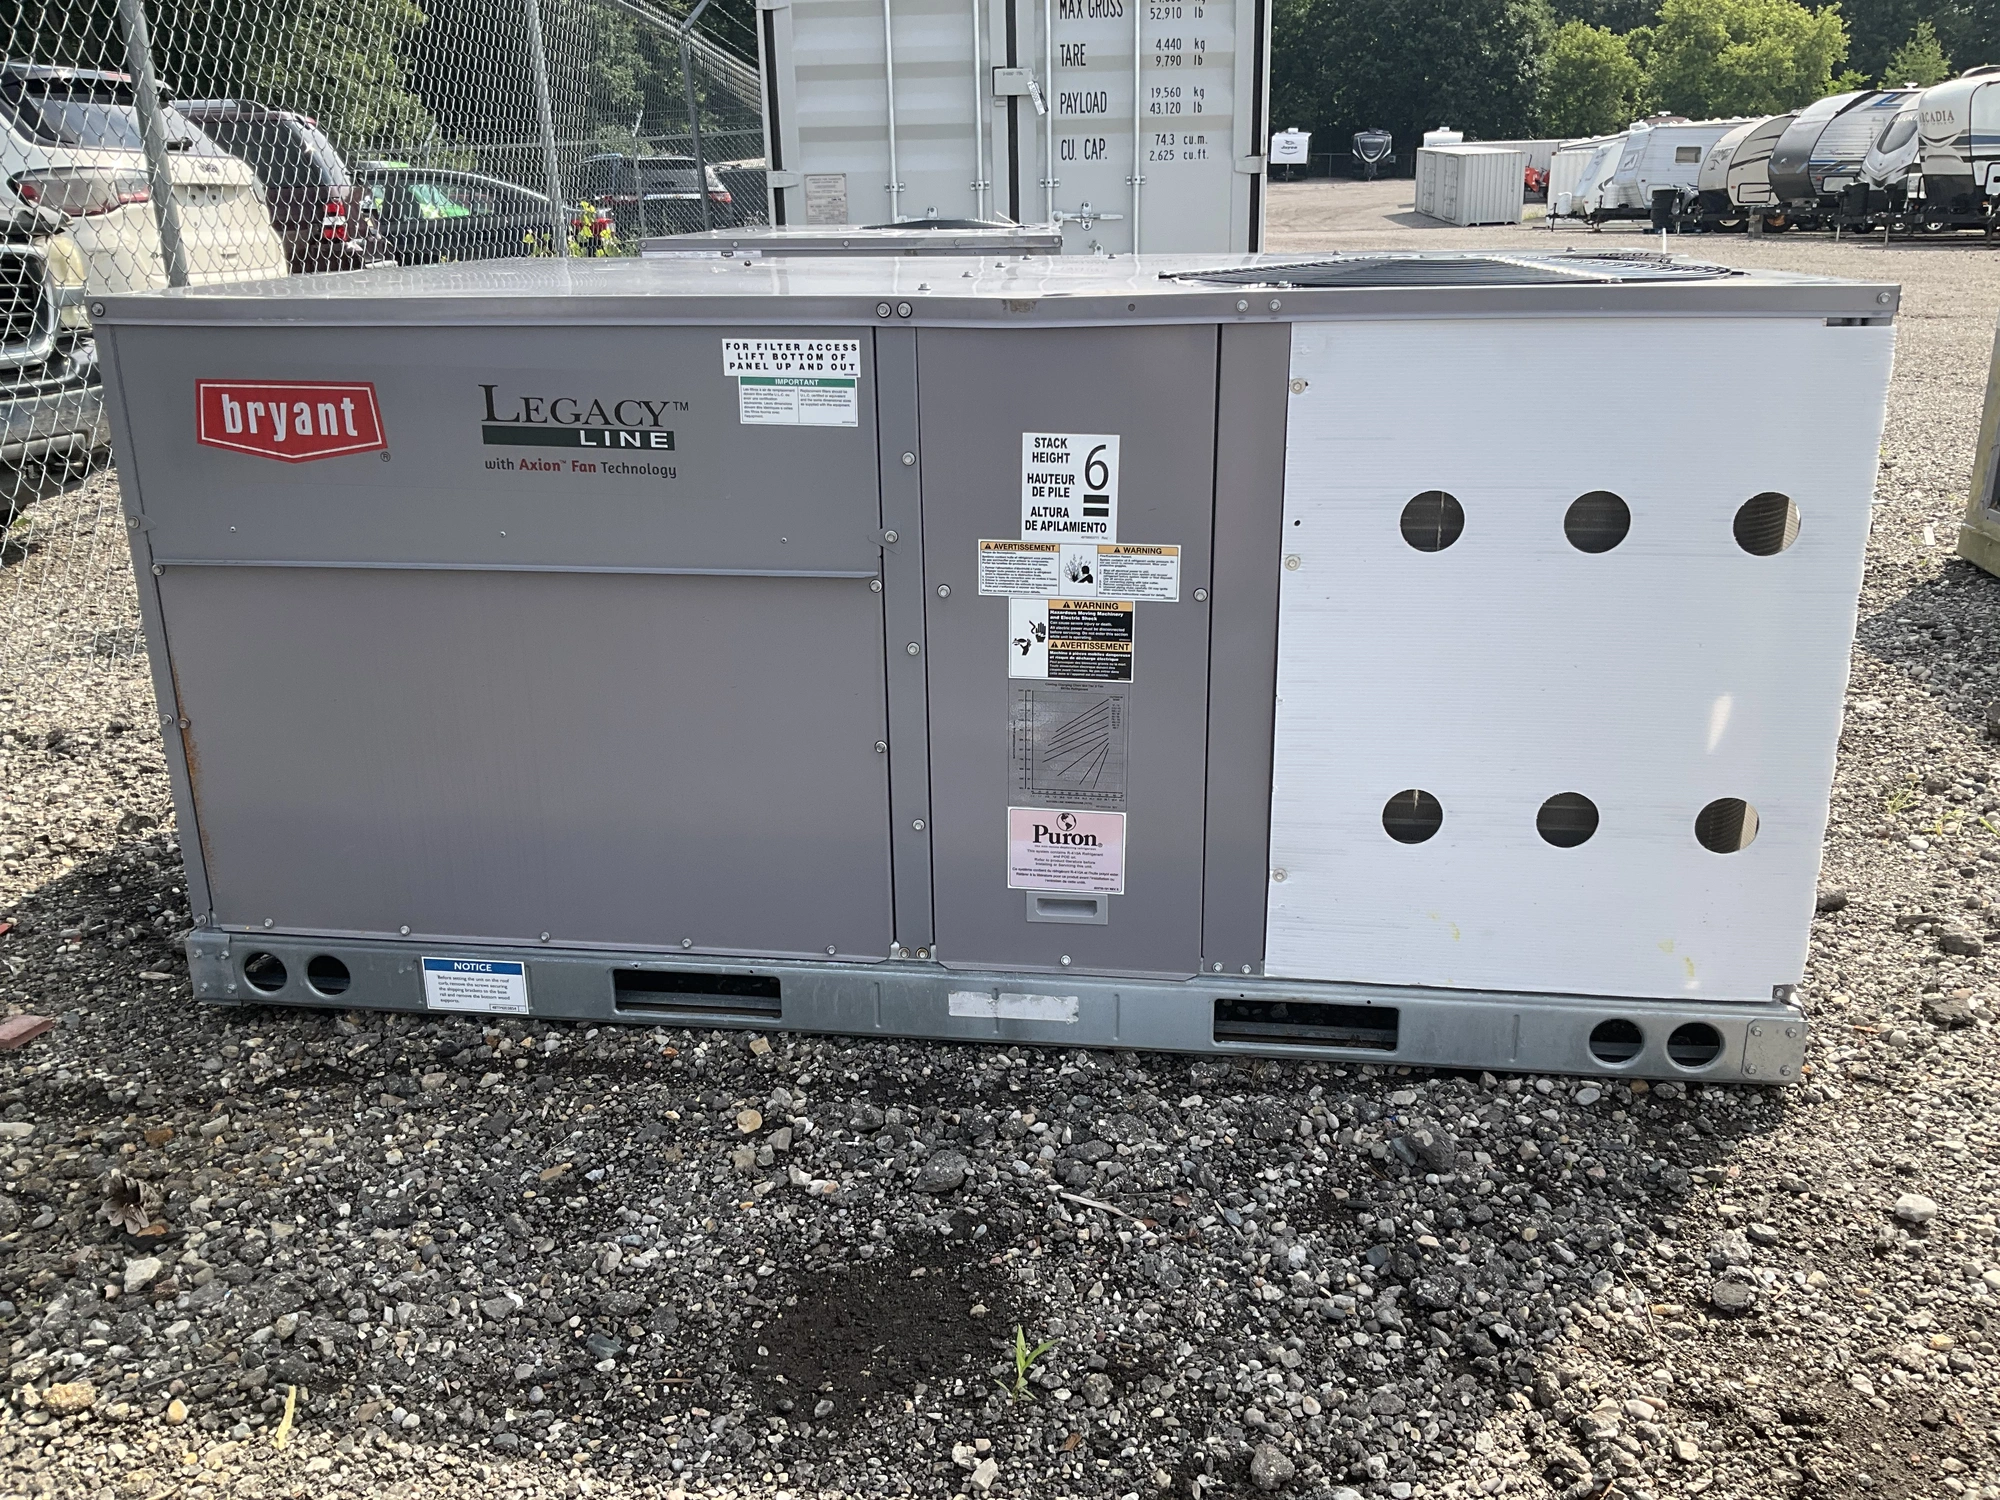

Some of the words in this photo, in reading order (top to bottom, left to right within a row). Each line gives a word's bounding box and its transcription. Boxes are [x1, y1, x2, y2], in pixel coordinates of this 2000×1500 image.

[1060, 0, 1083, 20] MAX
[1088, 0, 1123, 18] GROSS
[1194, 6, 1203, 18] lb
[1194, 38, 1205, 53] kg
[1060, 44, 1086, 67] TARE
[1194, 54, 1202, 65] lb
[1194, 86, 1204, 100] kg
[1060, 91, 1107, 114] PAYLOAD
[1194, 101, 1202, 113] lb
[1155, 134, 1174, 146] 74.3
[1184, 135, 1208, 145] cu.m.
[1061, 139, 1077, 160] CU.
[1084, 138, 1108, 160] CAP.
[1184, 149, 1209, 160] cu.ft.
[221, 393, 358, 442] bryant
[580, 430, 668, 448] LINE
[1034, 437, 1067, 449] STACK
[1032, 452, 1070, 463] HEIGHT
[485, 458, 514, 470] with
[572, 460, 596, 472] Fan
[600, 461, 676, 479] Technology
[1085, 444, 1108, 490] 6
[1027, 473, 1075, 485] HAUTEUR
[1032, 486, 1045, 497] DE
[1048, 487, 1070, 498] PILE
[1031, 506, 1069, 518] ALTURA
[1025, 520, 1037, 530] DE
[1040, 521, 1107, 533] APILAMIENTO
[1074, 602, 1118, 610] WARNING
[1060, 641, 1130, 650] AVERTISSEMENT
[454, 962, 492, 972] NOTICE
